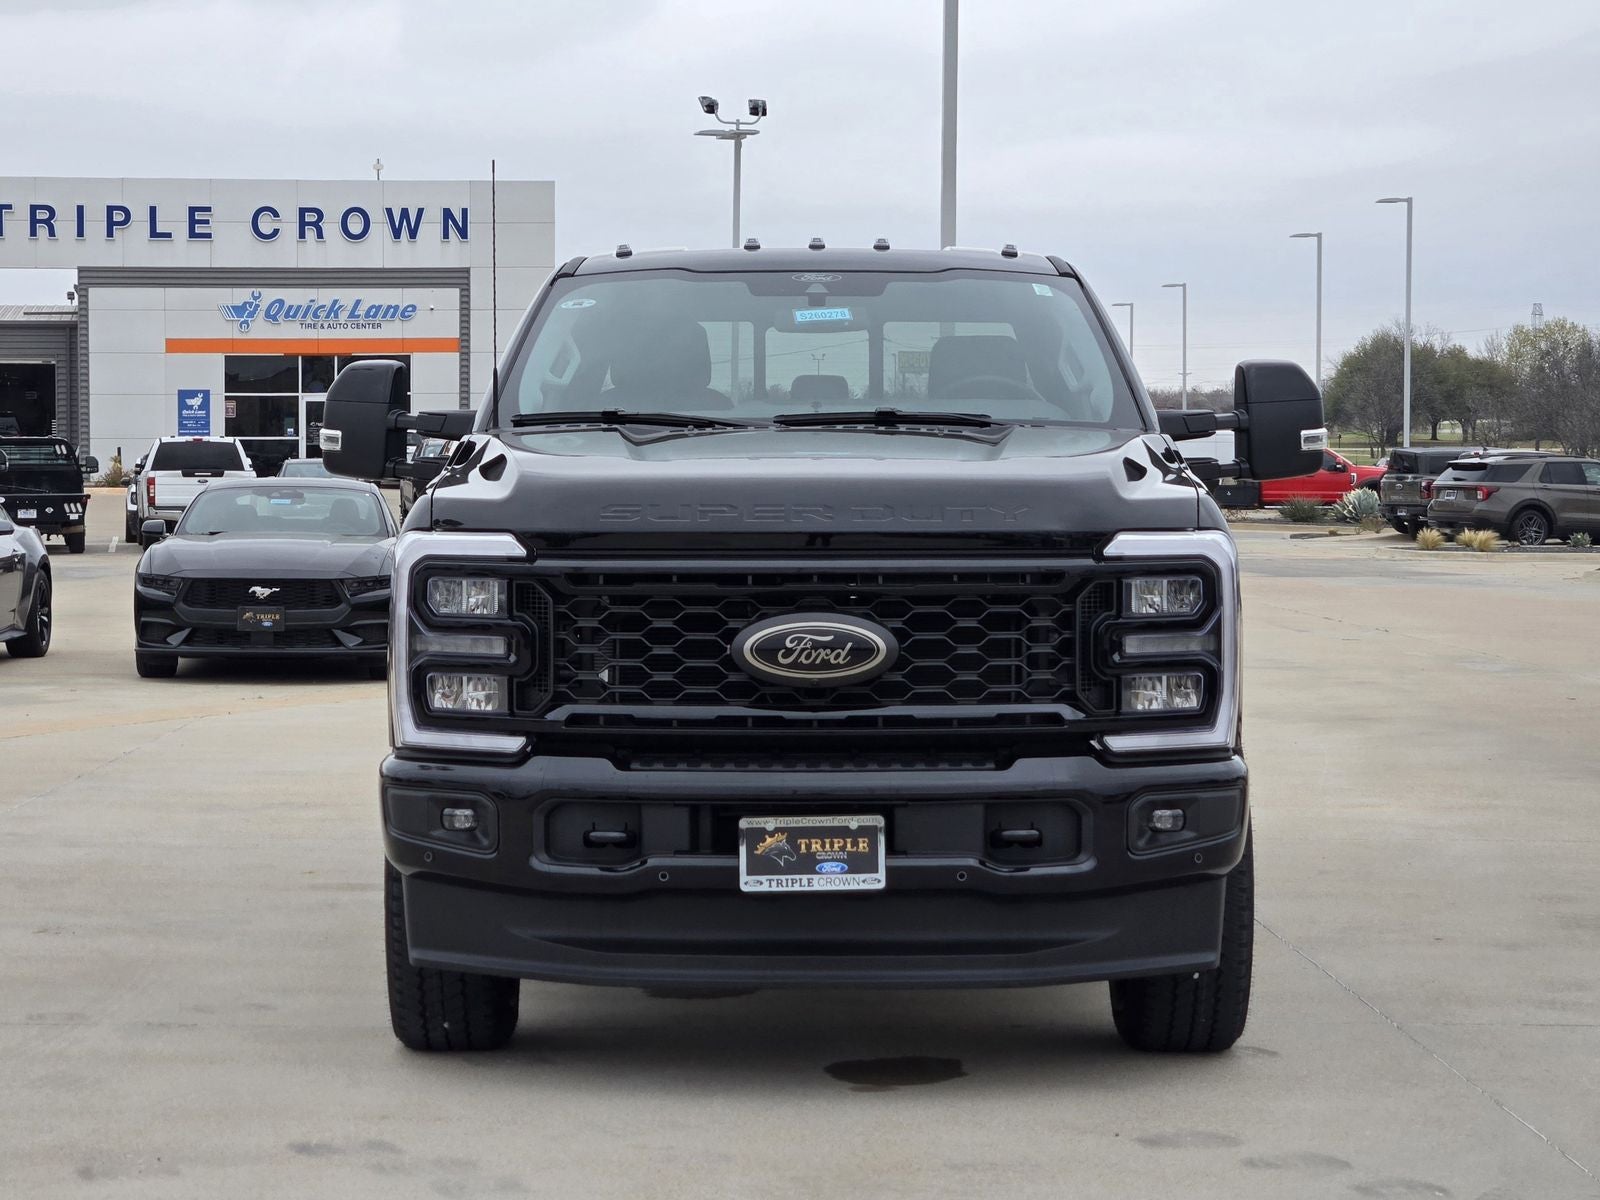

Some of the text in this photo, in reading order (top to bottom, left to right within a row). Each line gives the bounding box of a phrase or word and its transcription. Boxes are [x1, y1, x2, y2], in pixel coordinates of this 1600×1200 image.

[250, 206, 470, 242] CROWN
[264, 298, 418, 324] Quick Lane
[800, 311, 847, 320] S260278
[300, 322, 382, 330] TIRE & AUTO CENTER
[600, 504, 1032, 522] SUPER DUTY
[777, 633, 853, 665] Ford
[797, 838, 869, 853] TRIPLE
[816, 851, 847, 860] CROWN
[766, 878, 814, 888] TRIPLE
[817, 876, 860, 887] CROWN
